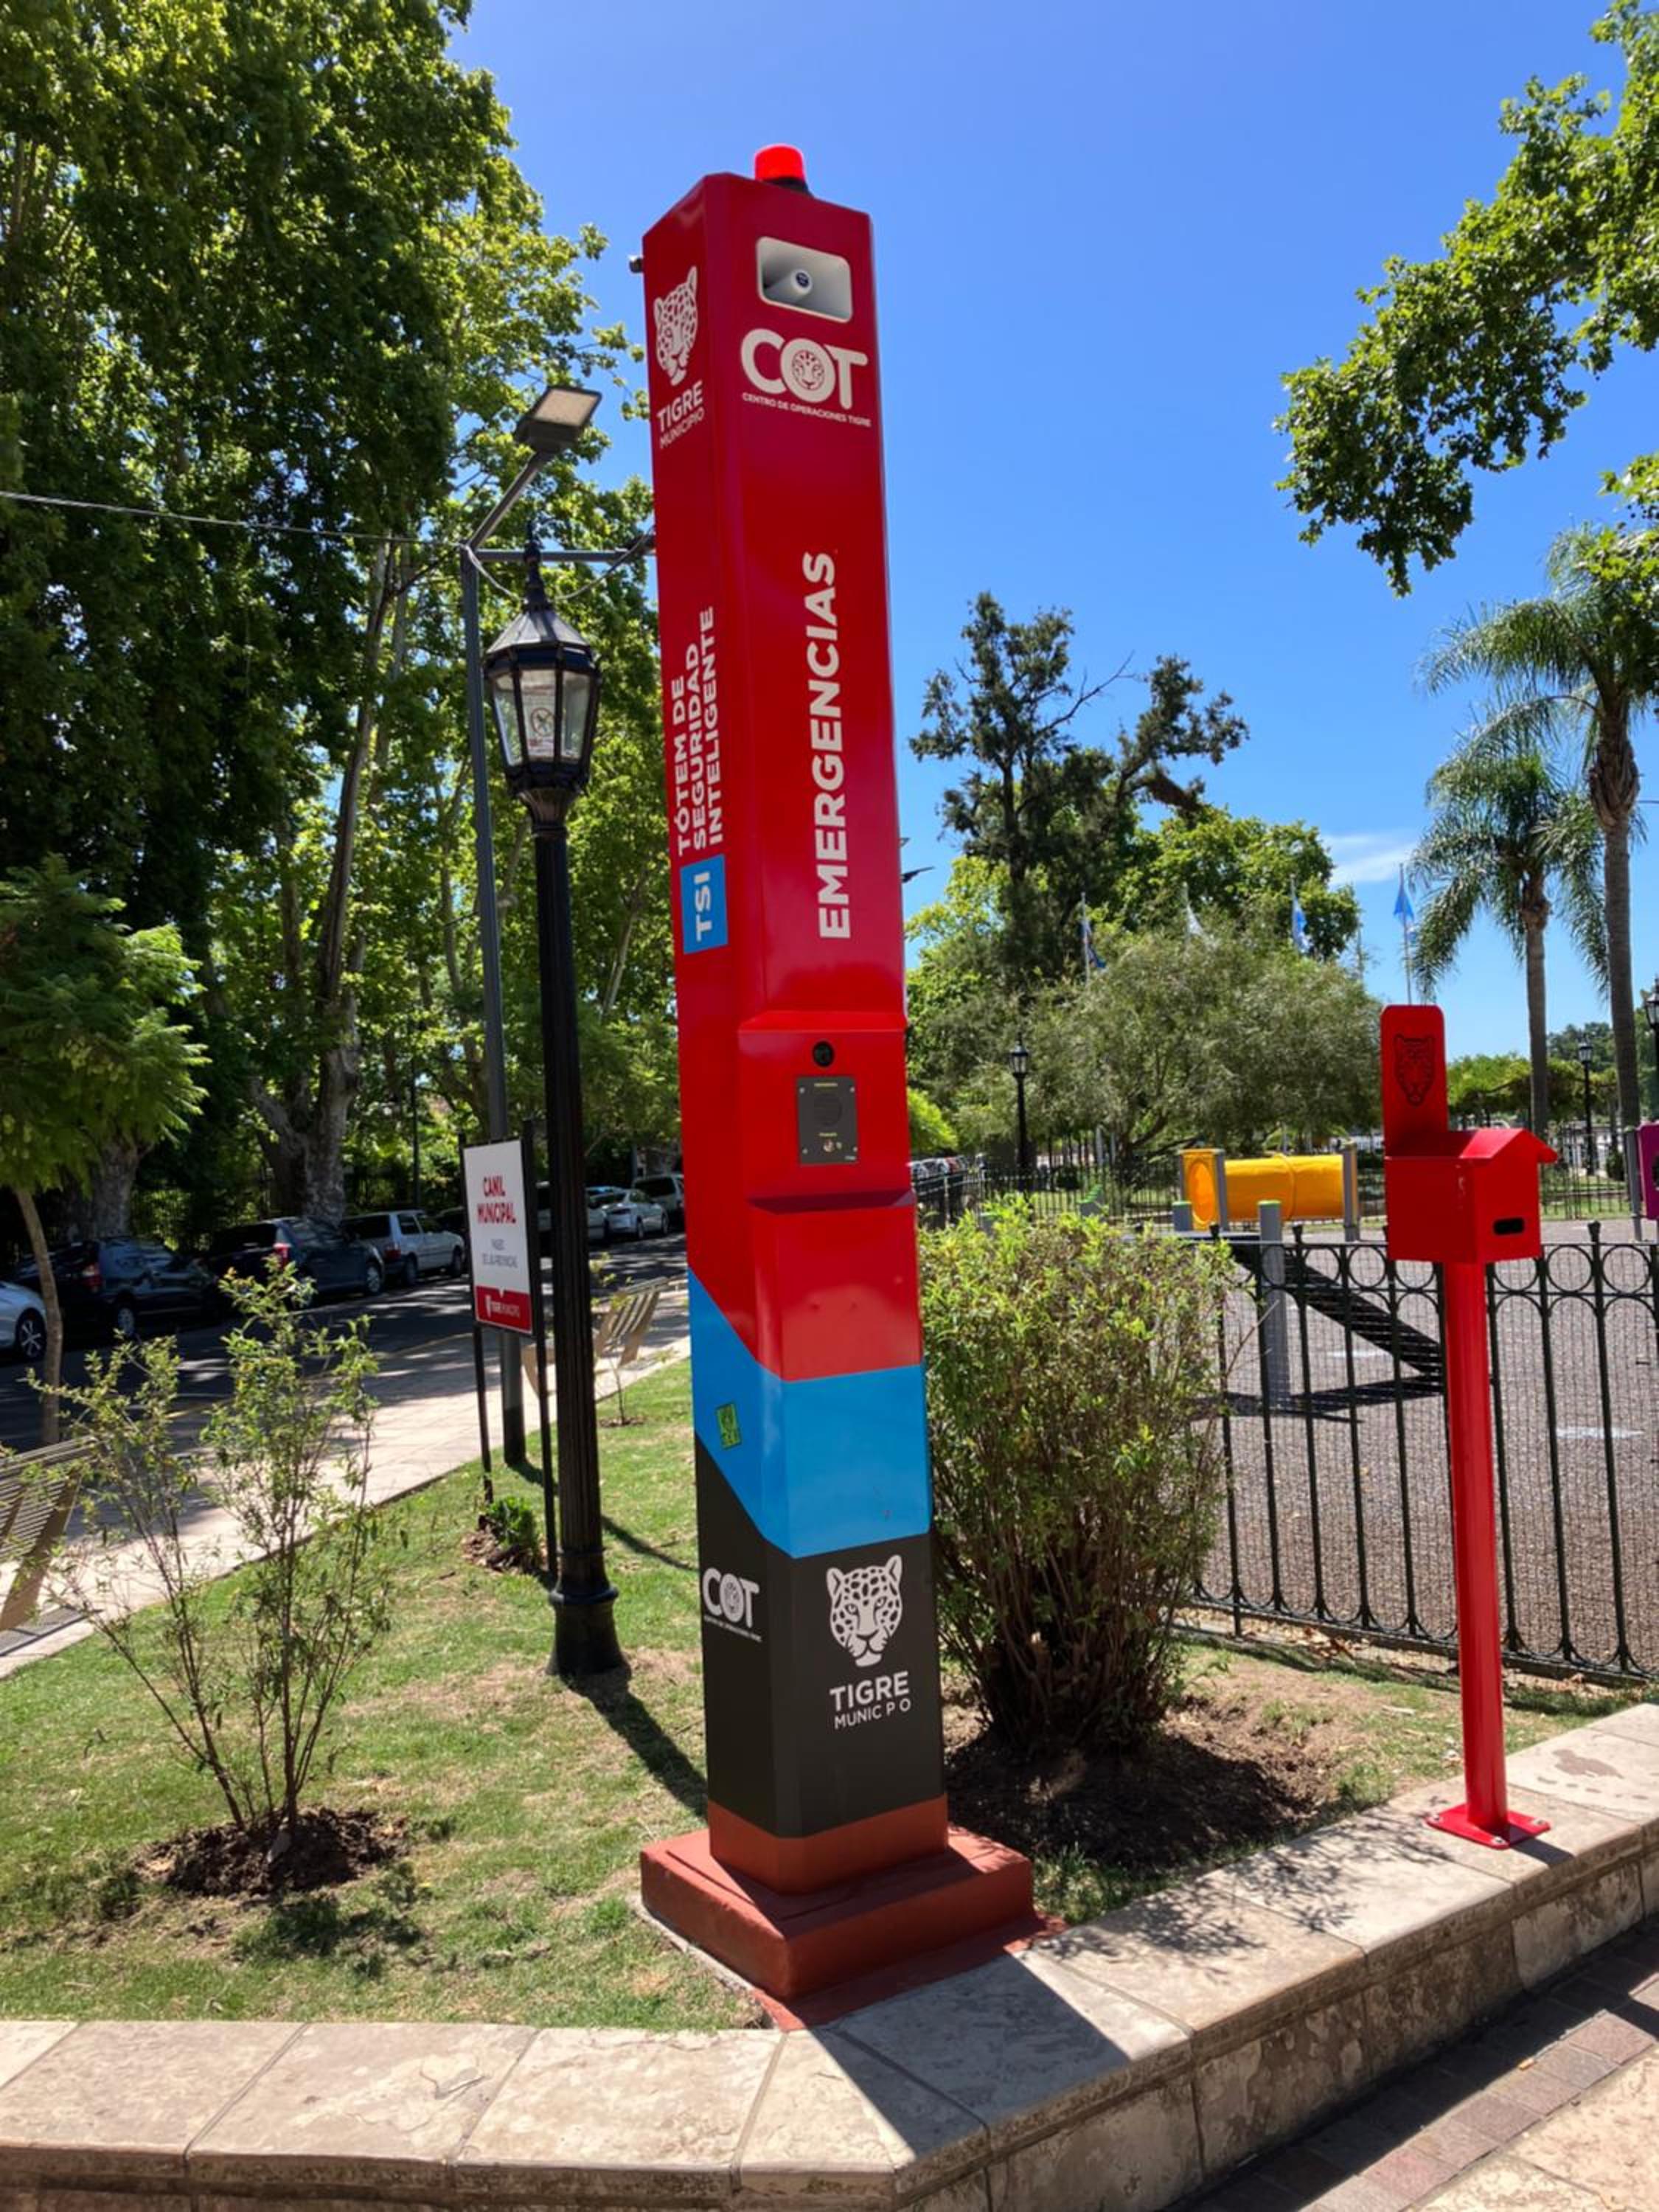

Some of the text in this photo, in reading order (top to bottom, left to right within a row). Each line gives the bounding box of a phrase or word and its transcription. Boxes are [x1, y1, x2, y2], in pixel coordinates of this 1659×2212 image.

[741, 328, 868, 409] COT
[657, 380, 703, 432] TIGRE
[777, 400, 789, 410] DE
[686, 643, 707, 849] SEGURIDAD
[700, 606, 723, 845] INTELIGENTE
[802, 552, 850, 939] EMERGENCIAS
[671, 676, 691, 857] TÓTEM DE
[694, 871, 713, 942] TSI
[702, 1568, 759, 1628] COT
[830, 1670, 909, 1711] TIGRE
[834, 1698, 911, 1730] MUNICPO
